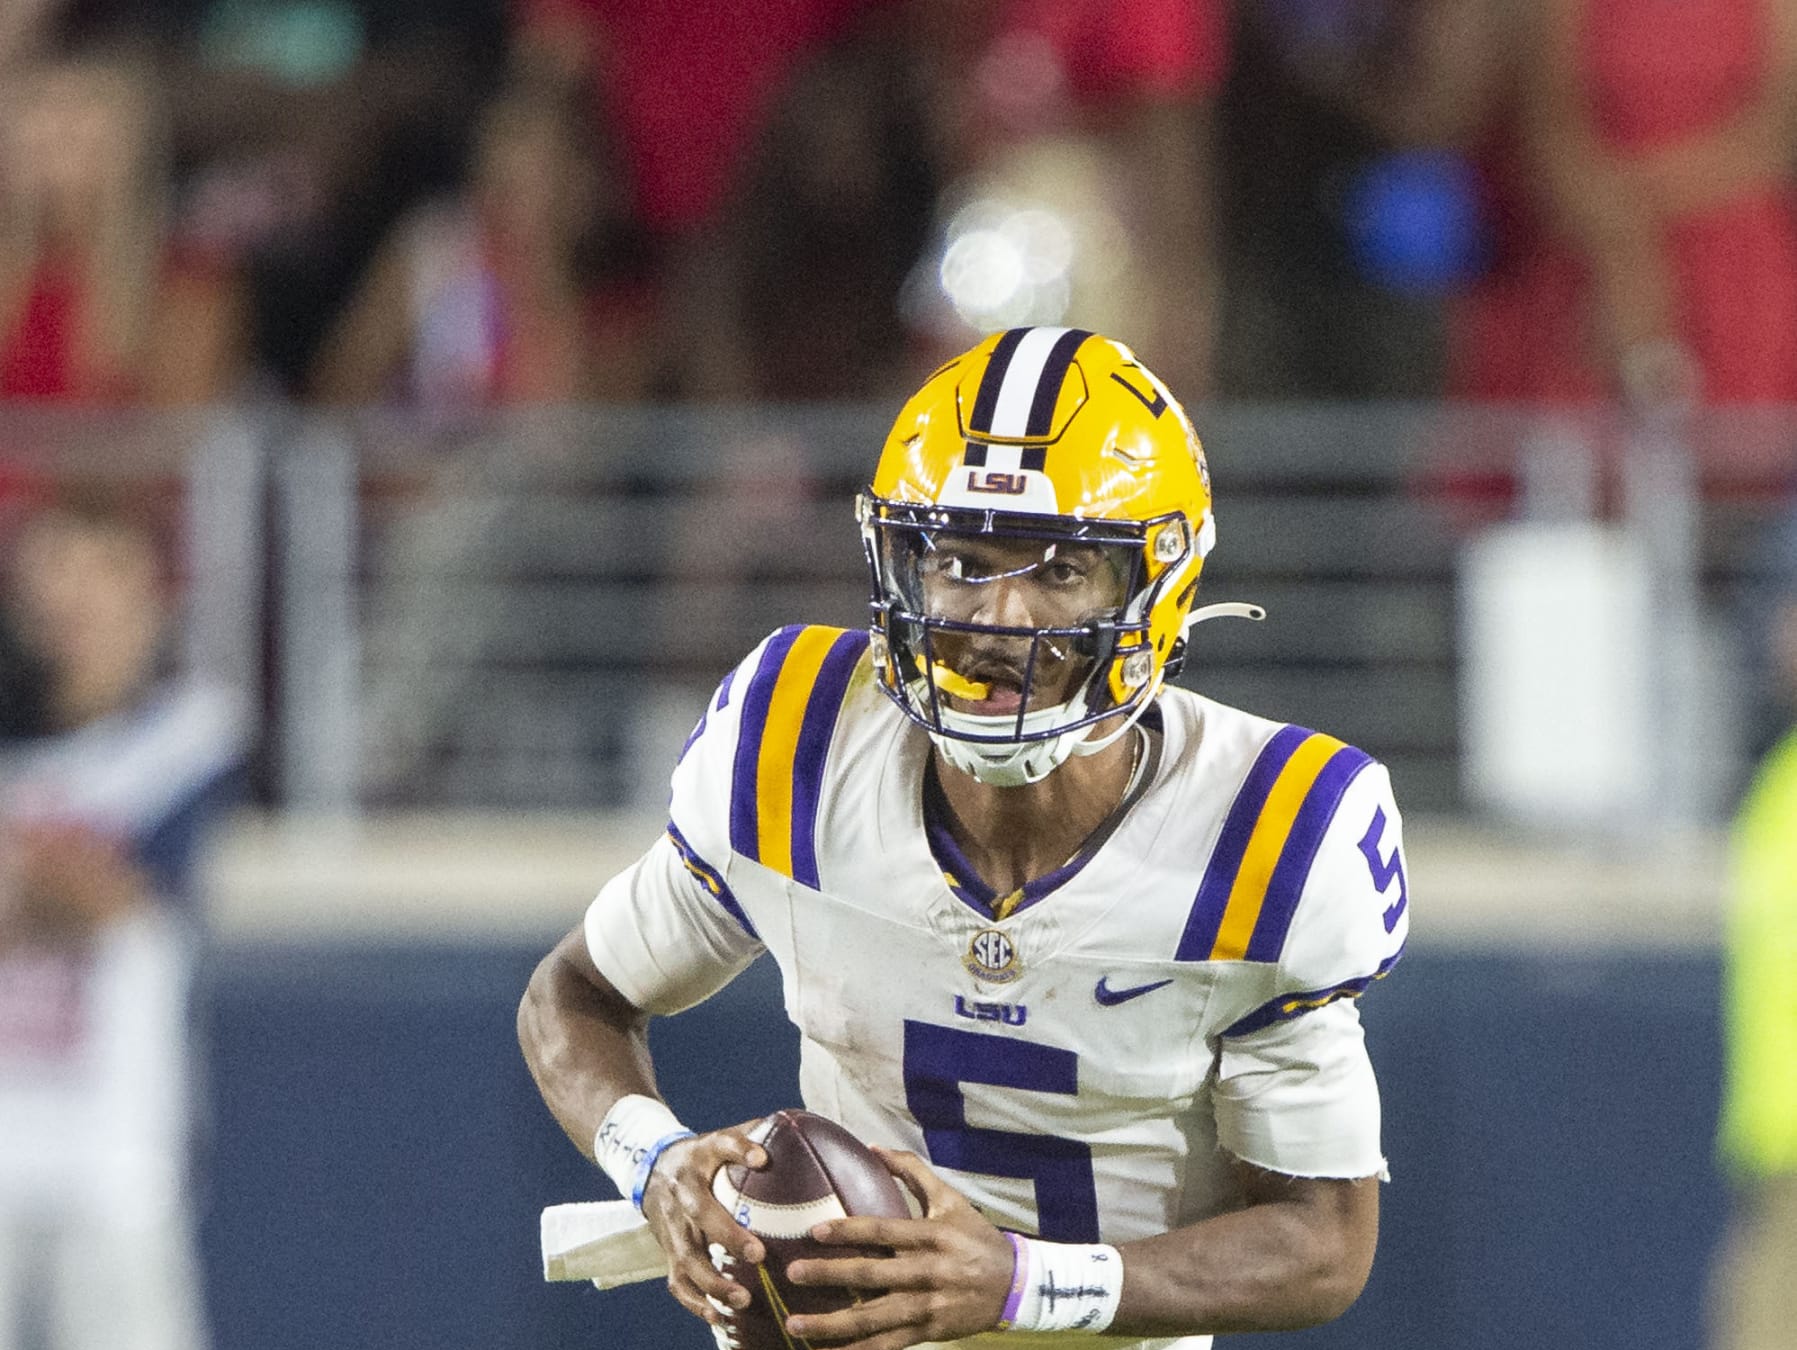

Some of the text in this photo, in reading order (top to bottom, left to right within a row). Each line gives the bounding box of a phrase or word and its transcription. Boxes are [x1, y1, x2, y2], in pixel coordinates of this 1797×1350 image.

[966, 471, 1027, 495] LSU
[1356, 803, 1409, 935] 5
[973, 931, 1013, 969] SEC
[953, 995, 1028, 1027] LSU
[902, 1019, 1100, 1244] 5
